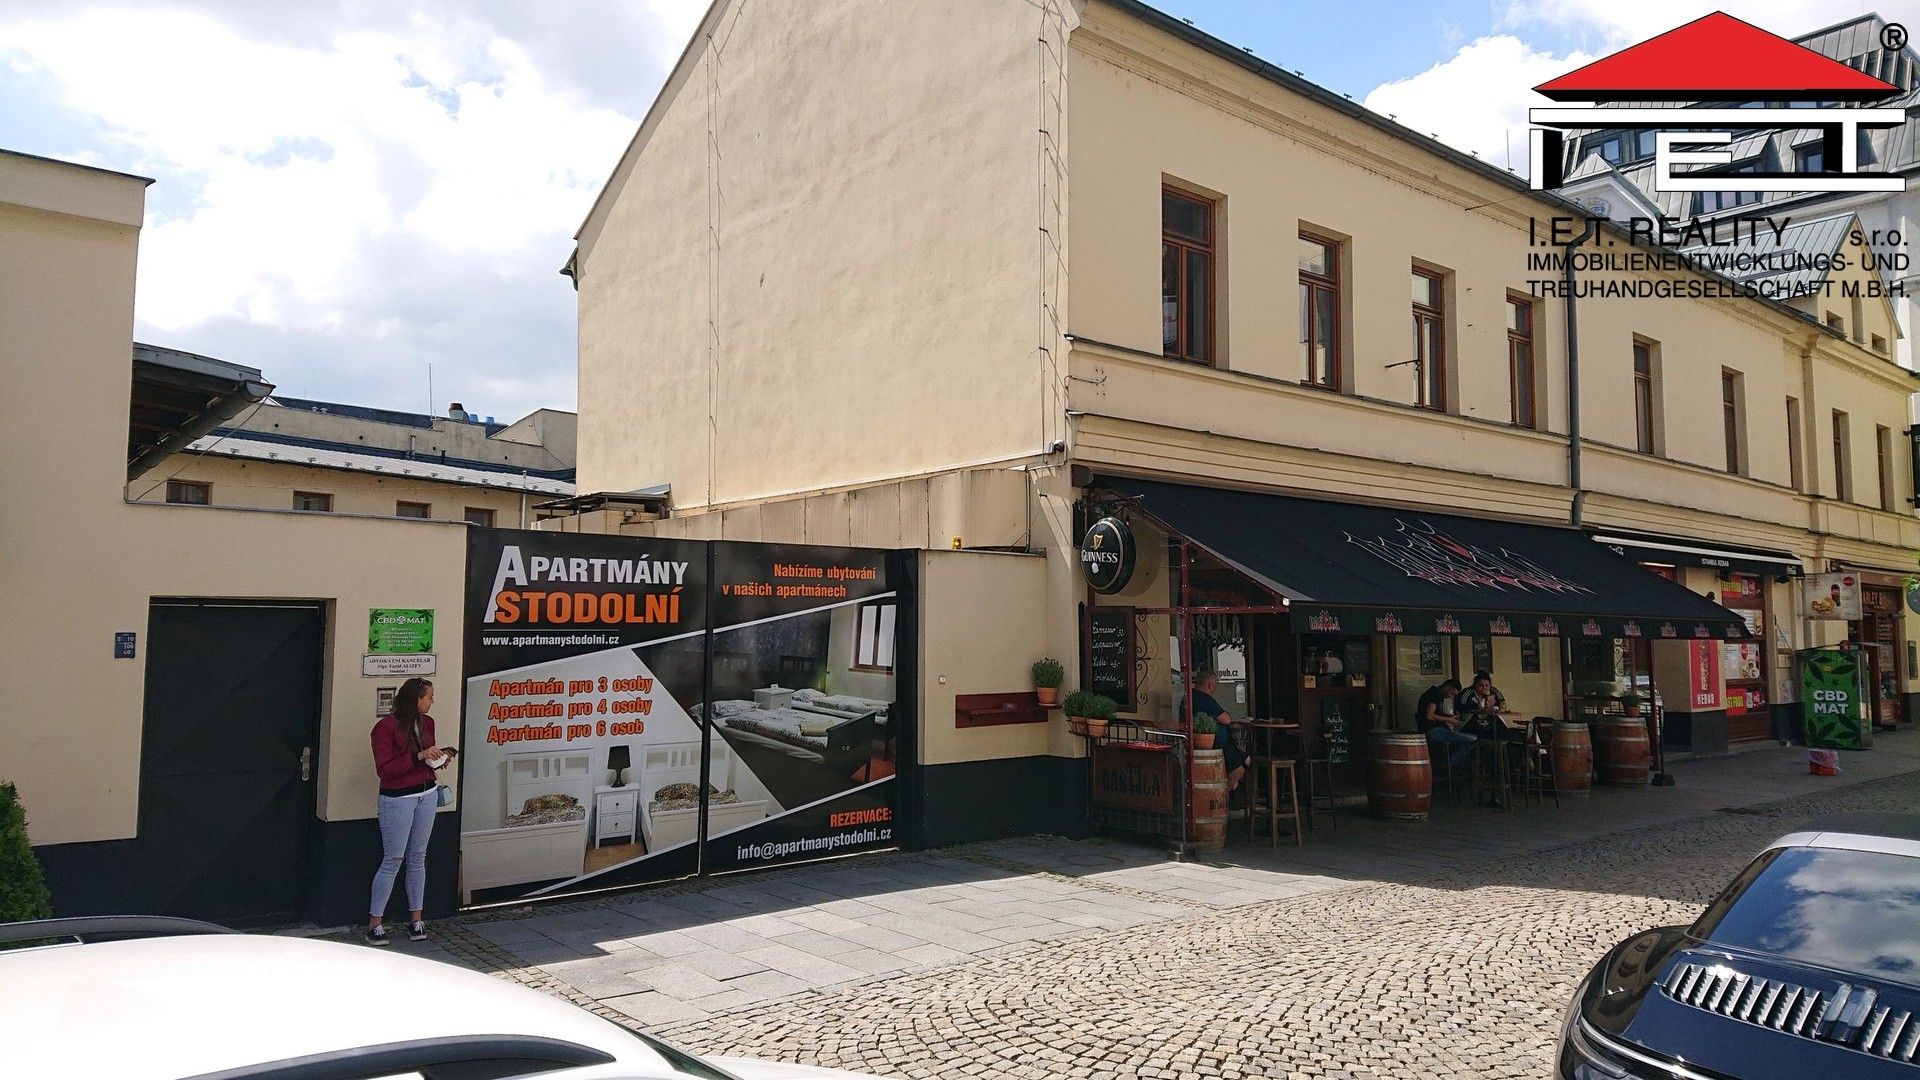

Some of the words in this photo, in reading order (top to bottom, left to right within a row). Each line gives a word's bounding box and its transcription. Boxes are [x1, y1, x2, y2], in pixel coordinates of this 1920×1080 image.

[1081, 549, 1119, 565] GUINNESS
[774, 563, 823, 580] Nabízíme
[826, 564, 877, 583] ubytování
[722, 584, 730, 597] v
[733, 579, 772, 597] našich
[776, 580, 847, 598] apartmánech
[495, 587, 680, 624] STODOLNÍ
[483, 633, 620, 648] www.apartmanystodolni.cz
[489, 678, 565, 700] Apartmán
[568, 680, 593, 698] pro
[597, 677, 608, 694] 3
[612, 675, 654, 696] osoby
[1813, 690, 1848, 702] CBD
[488, 701, 564, 723] Apartmán
[568, 702, 593, 719] pro
[596, 699, 608, 715] 4
[611, 697, 653, 717] osoby
[1813, 703, 1849, 715] MAT
[487, 724, 563, 746] Apartmán
[567, 724, 592, 741] pro
[596, 721, 607, 737] 6
[610, 719, 645, 736] osob
[830, 808, 893, 829] REZERVACE:
[737, 828, 893, 861] info@apartmanystodolni.cz
